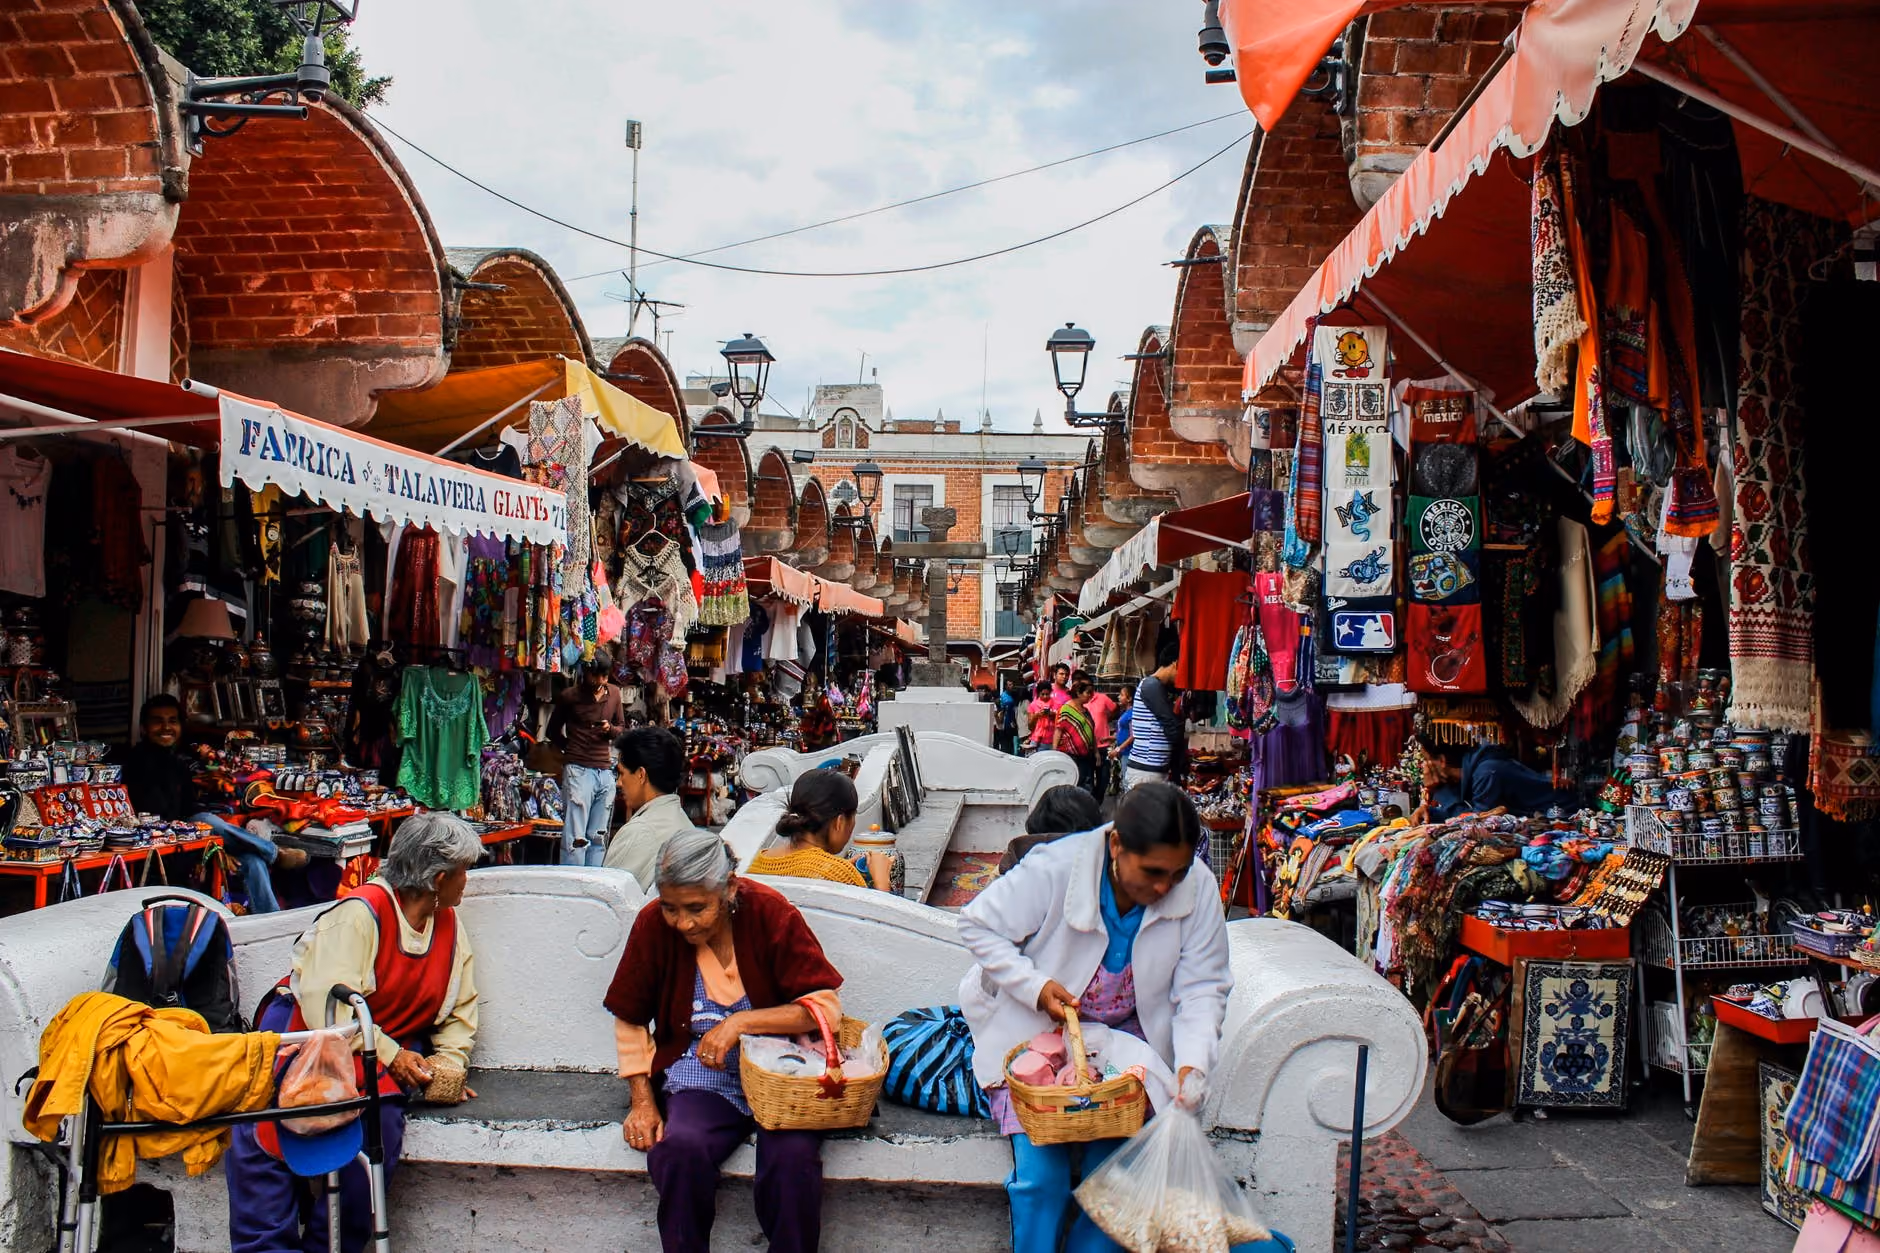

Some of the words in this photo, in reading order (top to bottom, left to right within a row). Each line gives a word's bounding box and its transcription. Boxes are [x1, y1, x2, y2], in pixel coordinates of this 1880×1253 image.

[239, 418, 356, 485] FABRICA
[362, 460, 373, 482] DE
[385, 463, 487, 513] TALAVERA
